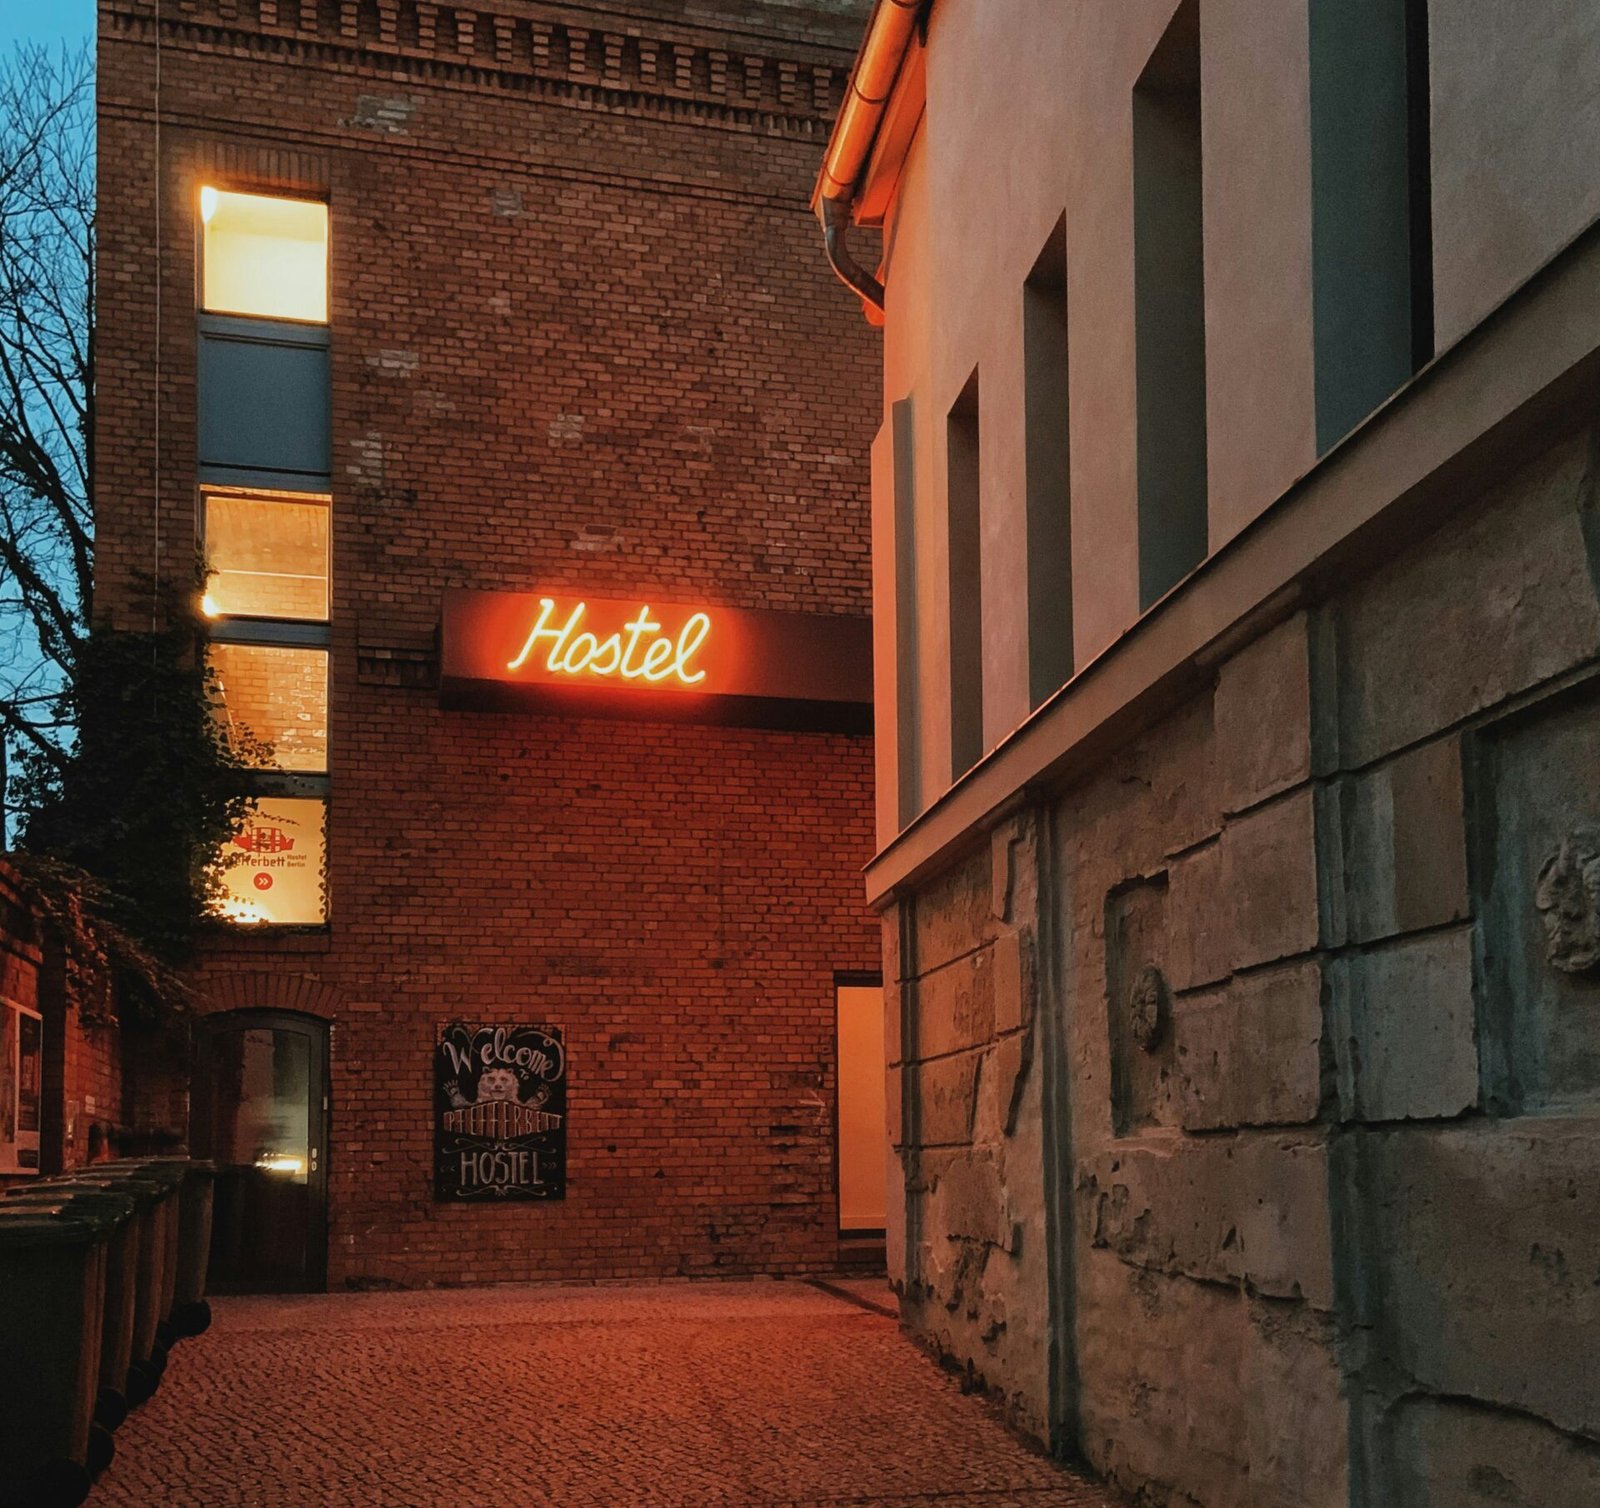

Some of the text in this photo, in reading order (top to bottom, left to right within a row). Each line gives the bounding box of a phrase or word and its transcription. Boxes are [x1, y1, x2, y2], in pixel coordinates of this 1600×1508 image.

[507, 598, 710, 683] Hostel
[443, 1028, 564, 1082] Welcome
[444, 1101, 562, 1140] PFEFFERBETT
[461, 1151, 544, 1185] HOSTEL
